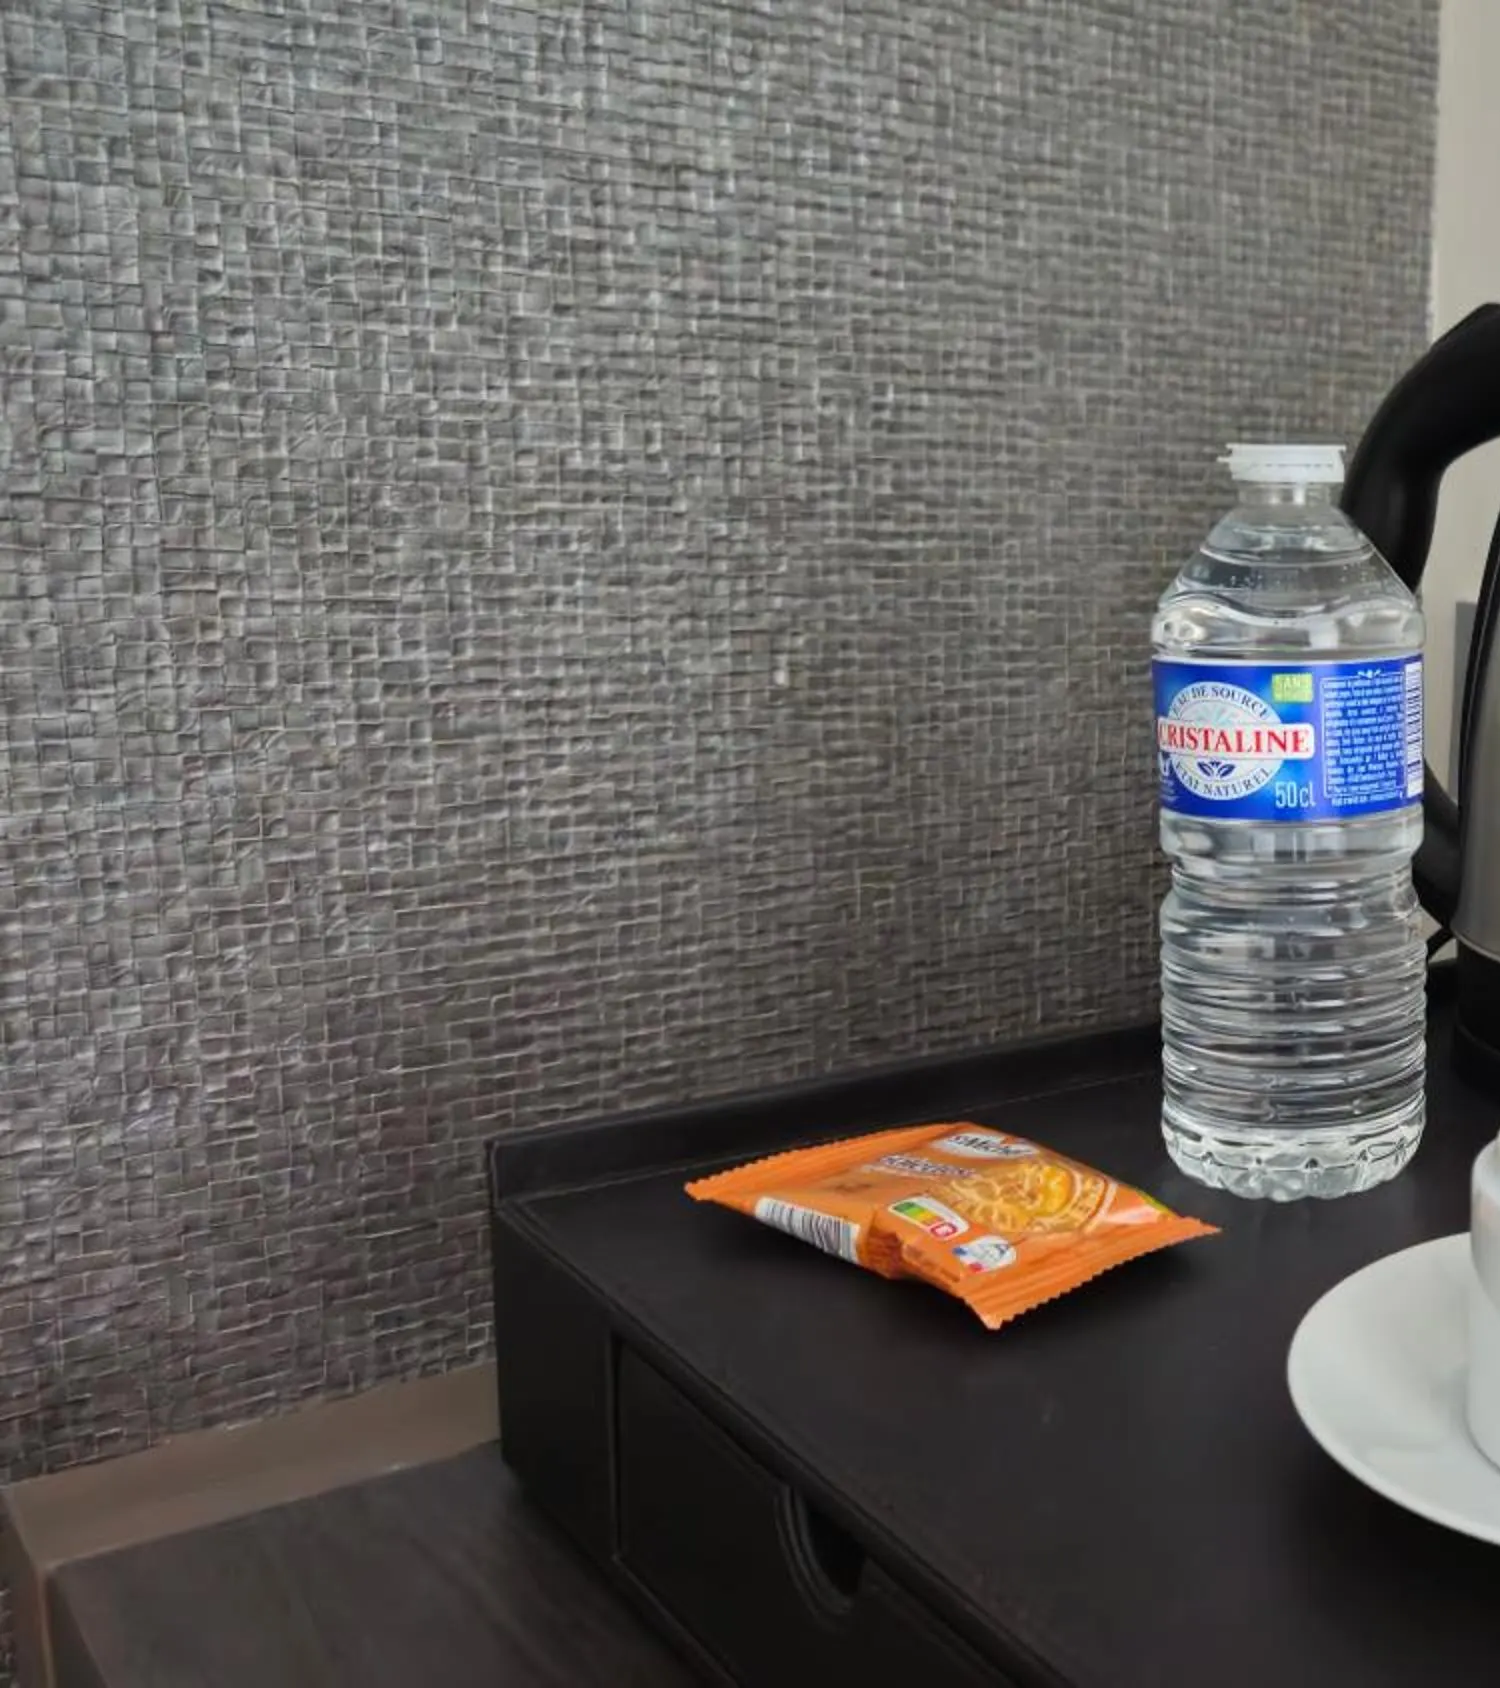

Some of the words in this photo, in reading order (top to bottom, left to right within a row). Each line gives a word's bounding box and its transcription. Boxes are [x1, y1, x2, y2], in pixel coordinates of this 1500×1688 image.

[1192, 685, 1208, 698] DE
[1211, 685, 1271, 718] SOURCE
[1158, 723, 1310, 754] CRISTALINE
